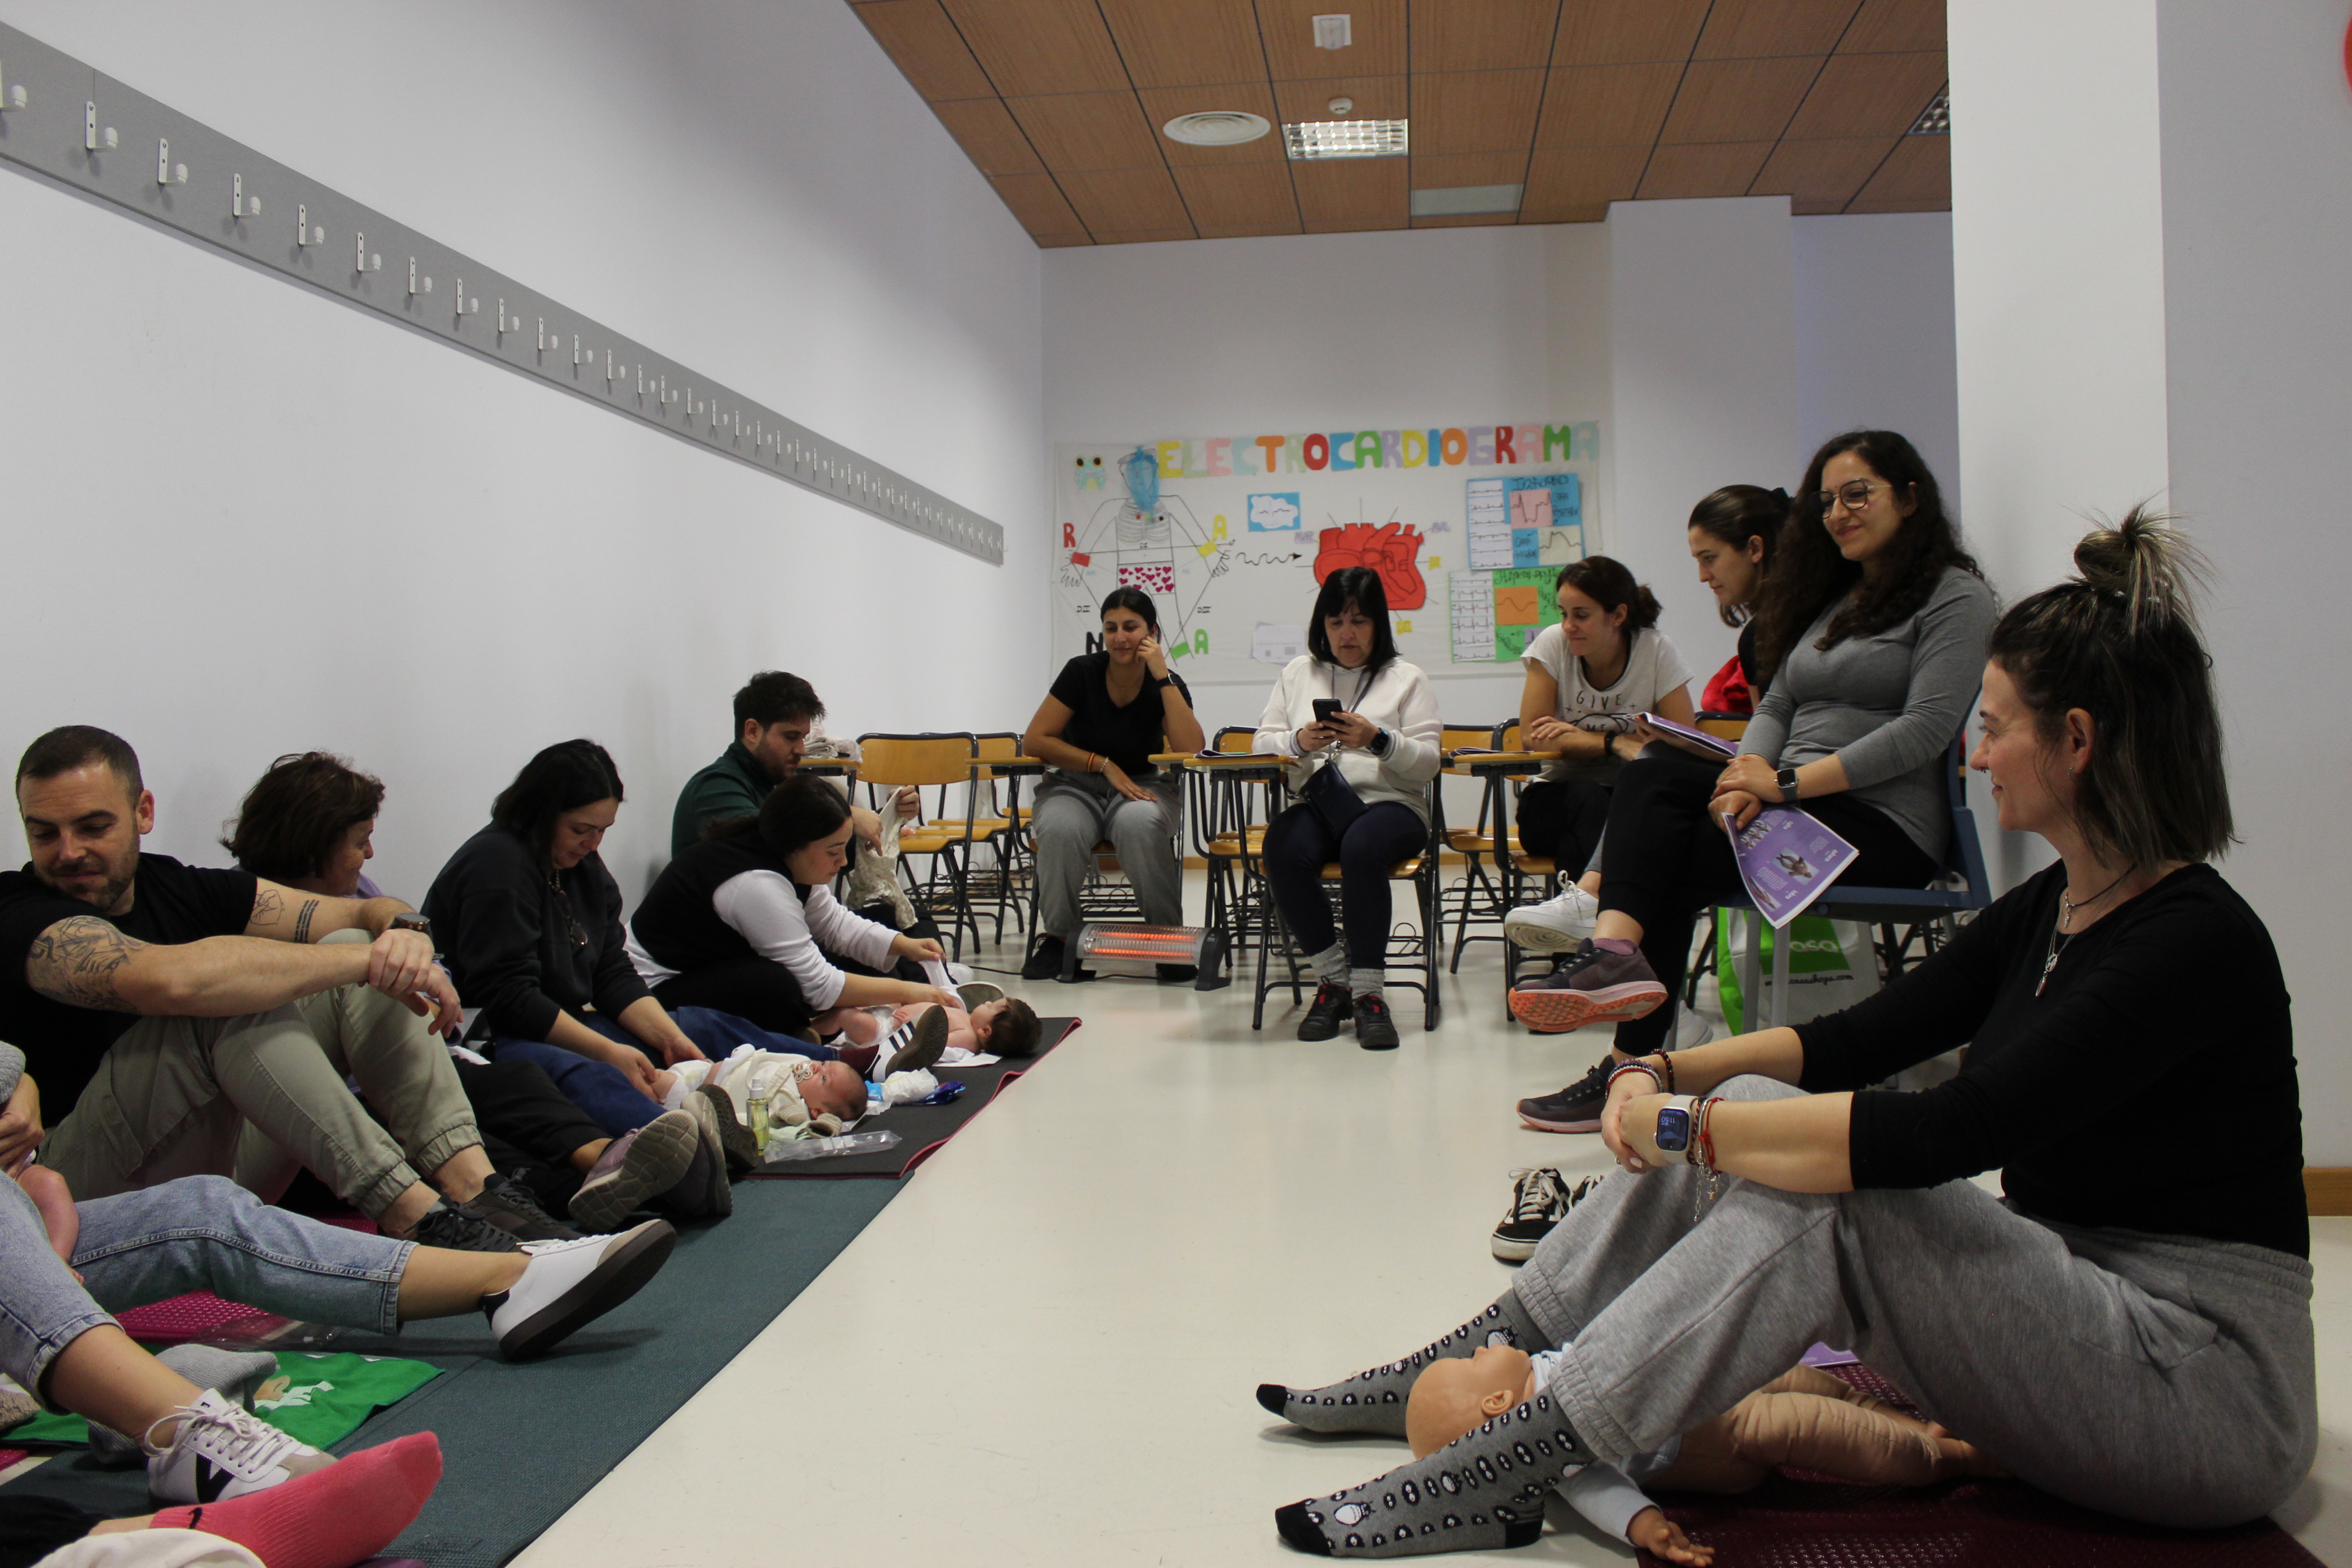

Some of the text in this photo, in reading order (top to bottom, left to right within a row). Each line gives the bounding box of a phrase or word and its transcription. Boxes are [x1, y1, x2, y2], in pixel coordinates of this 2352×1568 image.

[1157, 421, 1599, 478] ELECTROCARDIOGRAMA
[1063, 523, 1076, 548] R
[1213, 514, 1227, 540] A
[1086, 631, 1103, 654] N
[1194, 628, 1209, 654] A
[1576, 690, 1622, 710] GIVE
[1789, 940, 1839, 953] asa
